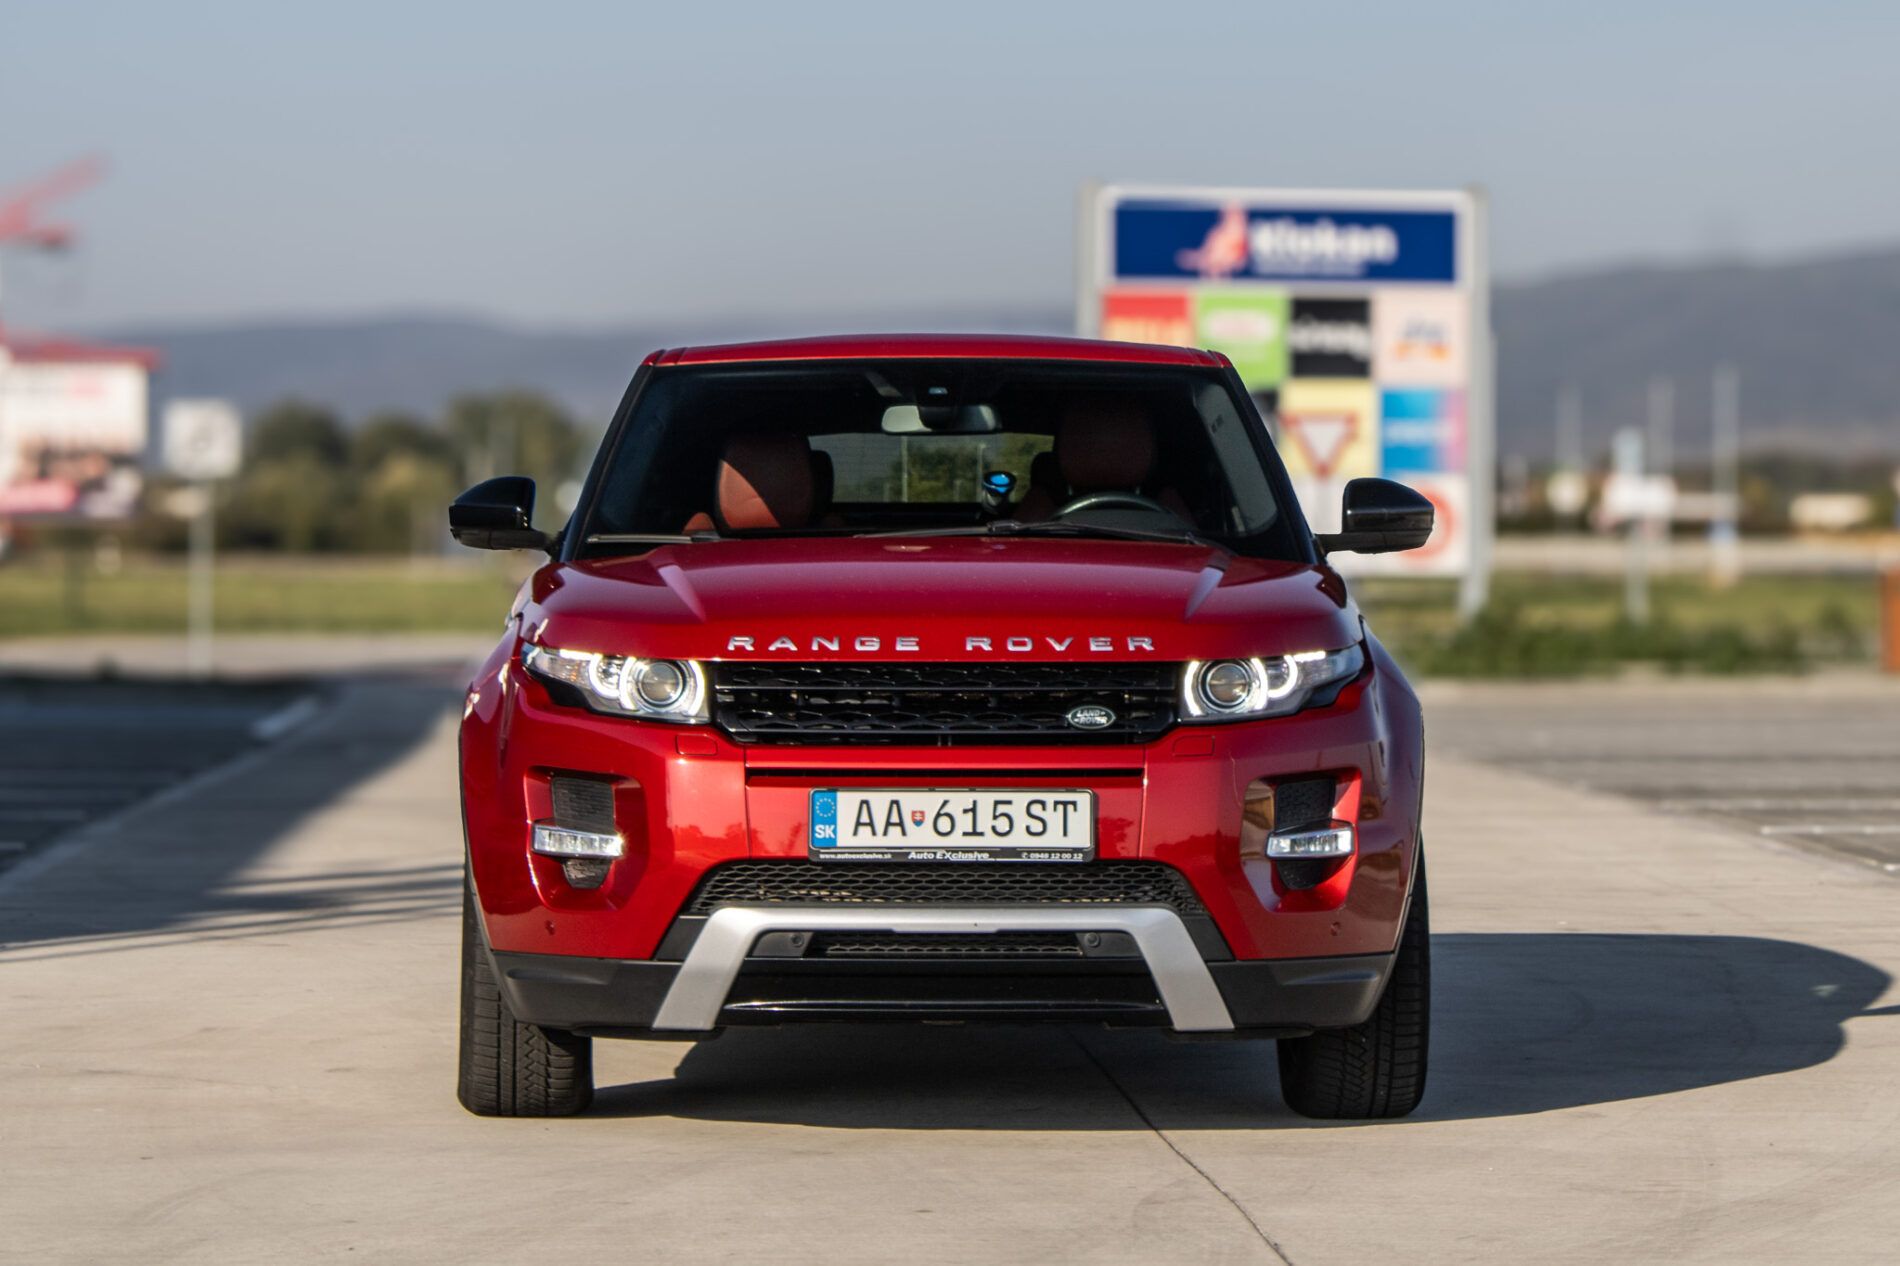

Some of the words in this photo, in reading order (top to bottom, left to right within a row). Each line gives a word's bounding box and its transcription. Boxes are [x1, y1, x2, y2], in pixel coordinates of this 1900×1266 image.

[727, 636, 920, 652] RANGE
[965, 636, 1155, 652] ROVER
[852, 799, 908, 837] AA
[815, 824, 836, 839] SK
[908, 851, 935, 860] Auto
